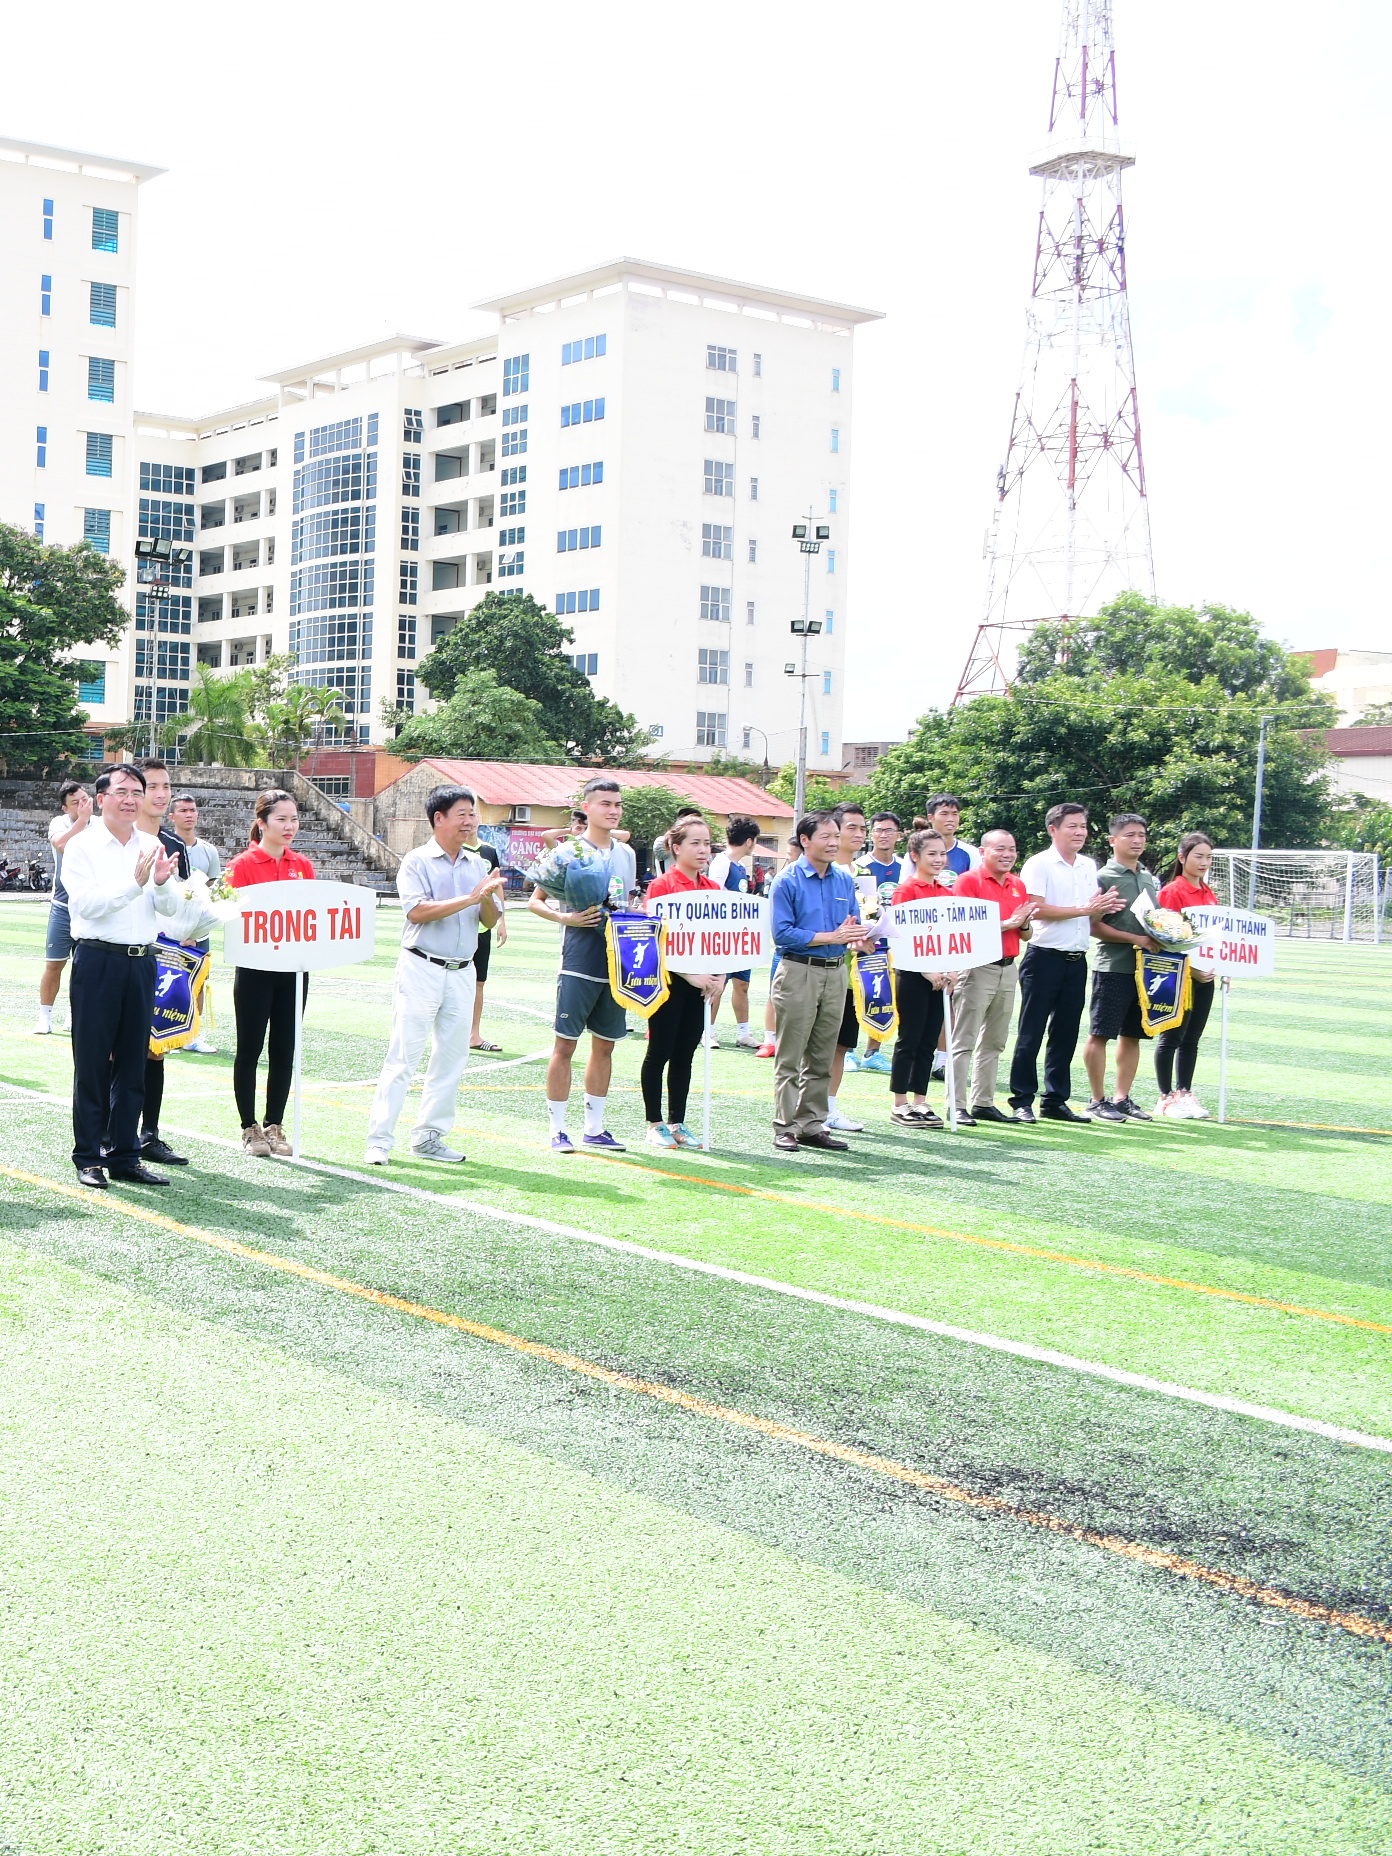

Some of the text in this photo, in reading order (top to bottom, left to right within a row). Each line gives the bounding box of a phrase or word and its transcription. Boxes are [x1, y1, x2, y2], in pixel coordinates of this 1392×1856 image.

[686, 894, 727, 921] QUẢNG
[909, 908, 939, 925] TRUNG
[946, 902, 966, 922] TÂM
[968, 905, 988, 921] ANH
[241, 899, 361, 951] TRỌNG TÀI
[665, 922, 696, 956] HỦY
[701, 926, 761, 956] NGUYÊN
[913, 925, 972, 957] HẢI AN
[1219, 937, 1258, 965] CHÂN
